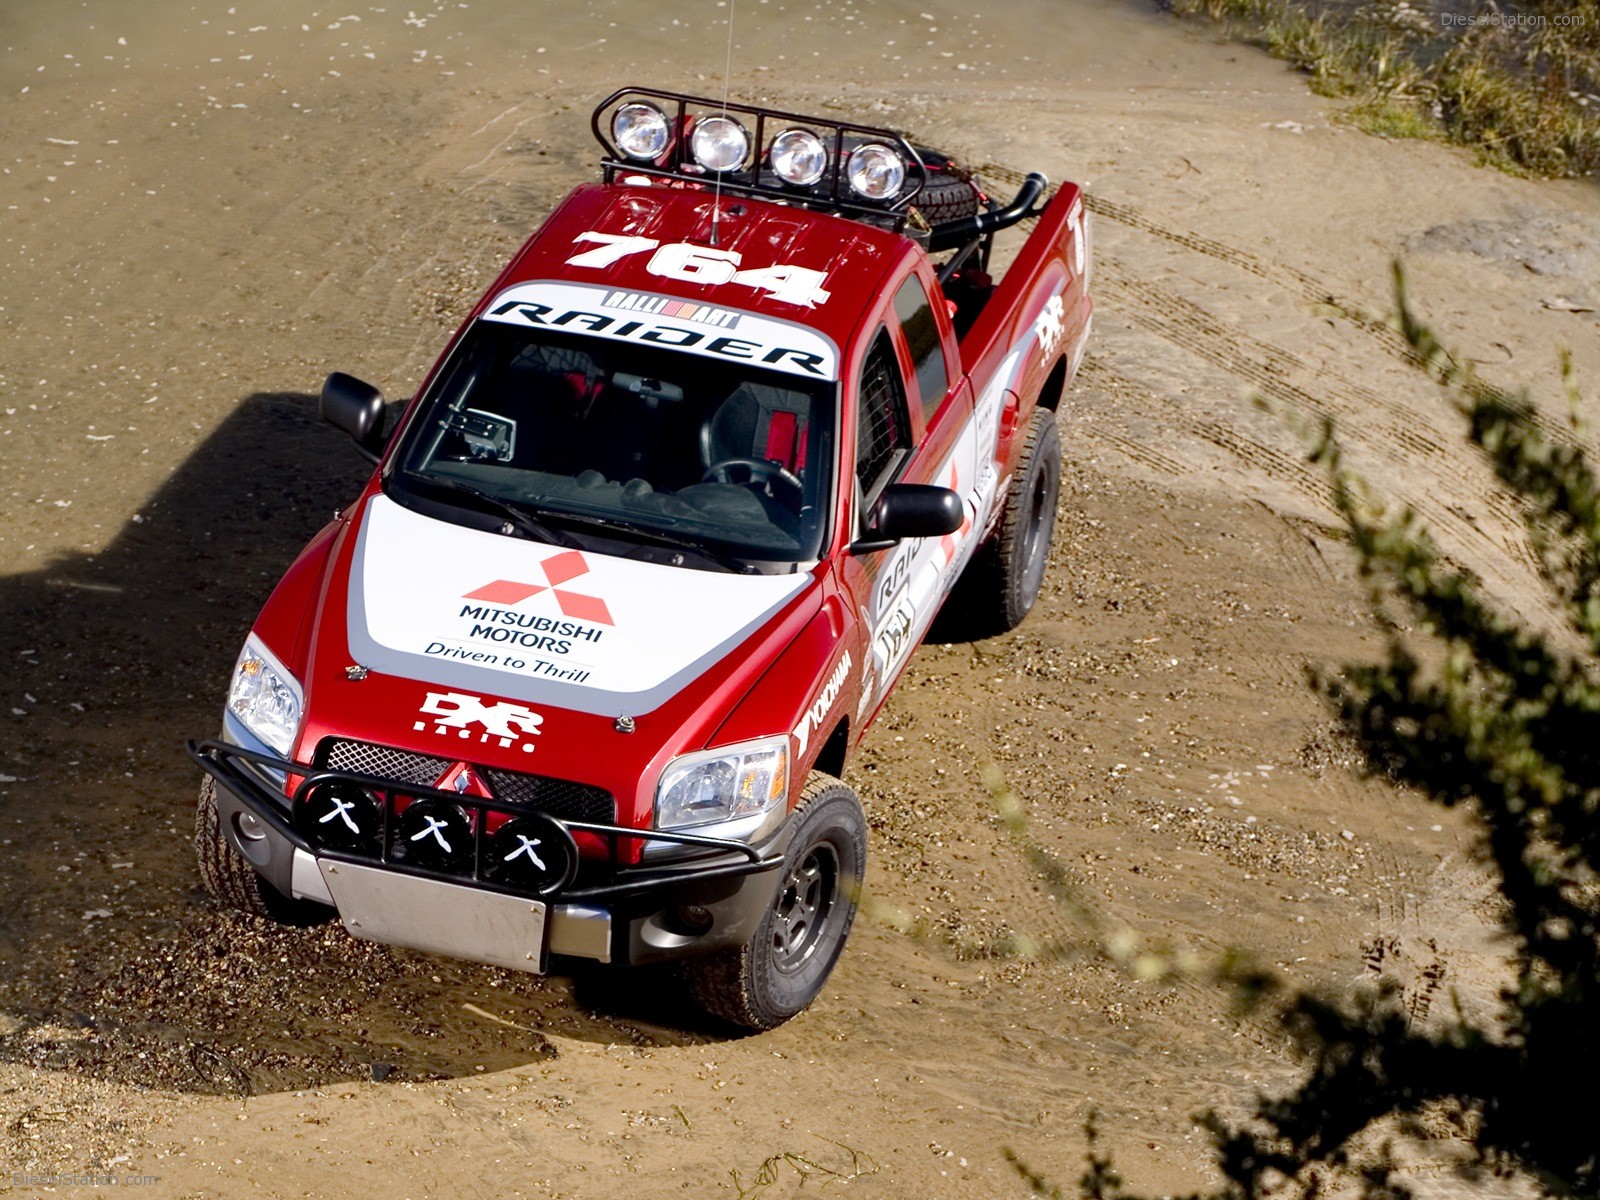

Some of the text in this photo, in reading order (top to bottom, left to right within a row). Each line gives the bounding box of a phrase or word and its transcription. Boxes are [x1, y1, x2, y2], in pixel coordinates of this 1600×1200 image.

[564, 231, 832, 310] 764
[605, 290, 740, 328] RALLI ART
[489, 300, 828, 376] RAIDER
[459, 604, 603, 643] MITSUBISHI
[469, 624, 572, 655] MOTORS
[424, 642, 591, 683] Driven to Thrill
[808, 650, 852, 731] YOKOHAMA
